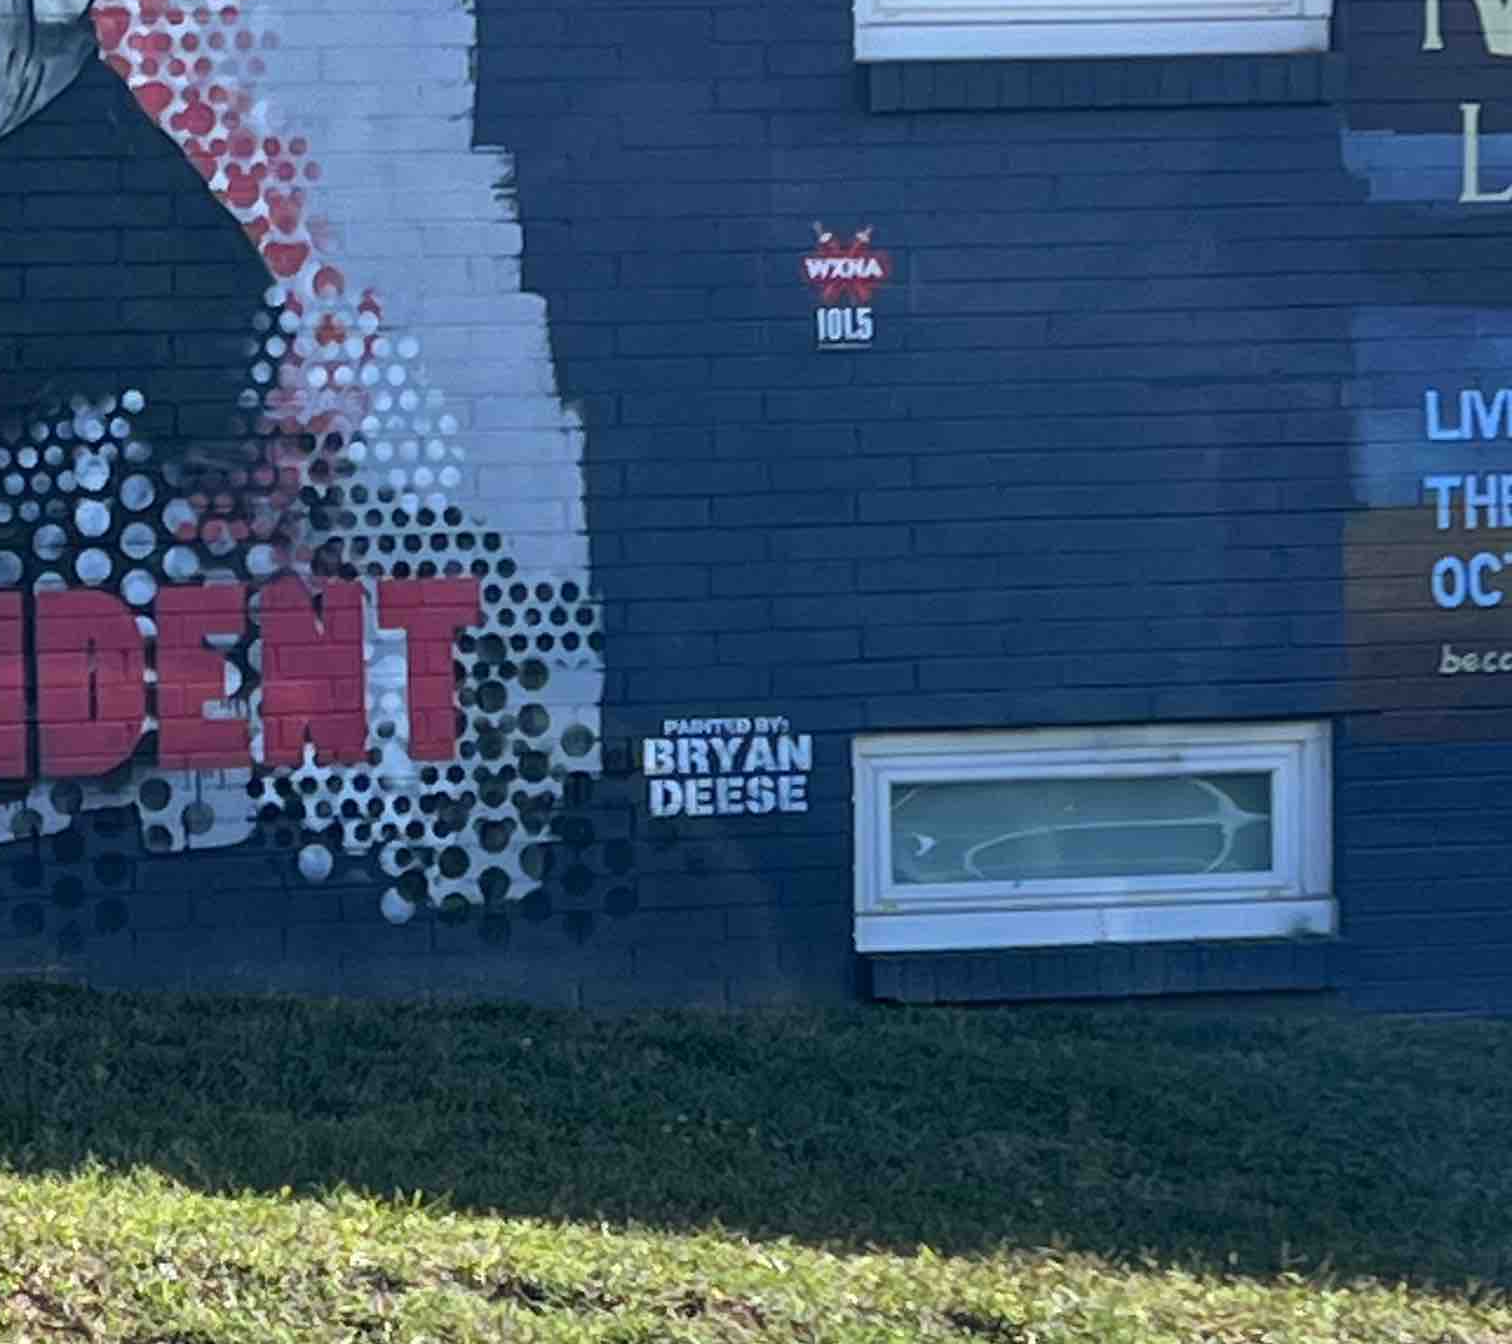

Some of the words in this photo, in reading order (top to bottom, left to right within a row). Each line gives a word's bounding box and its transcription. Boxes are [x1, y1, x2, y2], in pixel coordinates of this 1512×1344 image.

[804, 256, 885, 279] WXNA
[1425, 388, 1512, 441] LIV
[663, 717, 751, 736] PAINTED
[642, 734, 813, 777] BRYAN
[650, 774, 809, 817] DEESE
